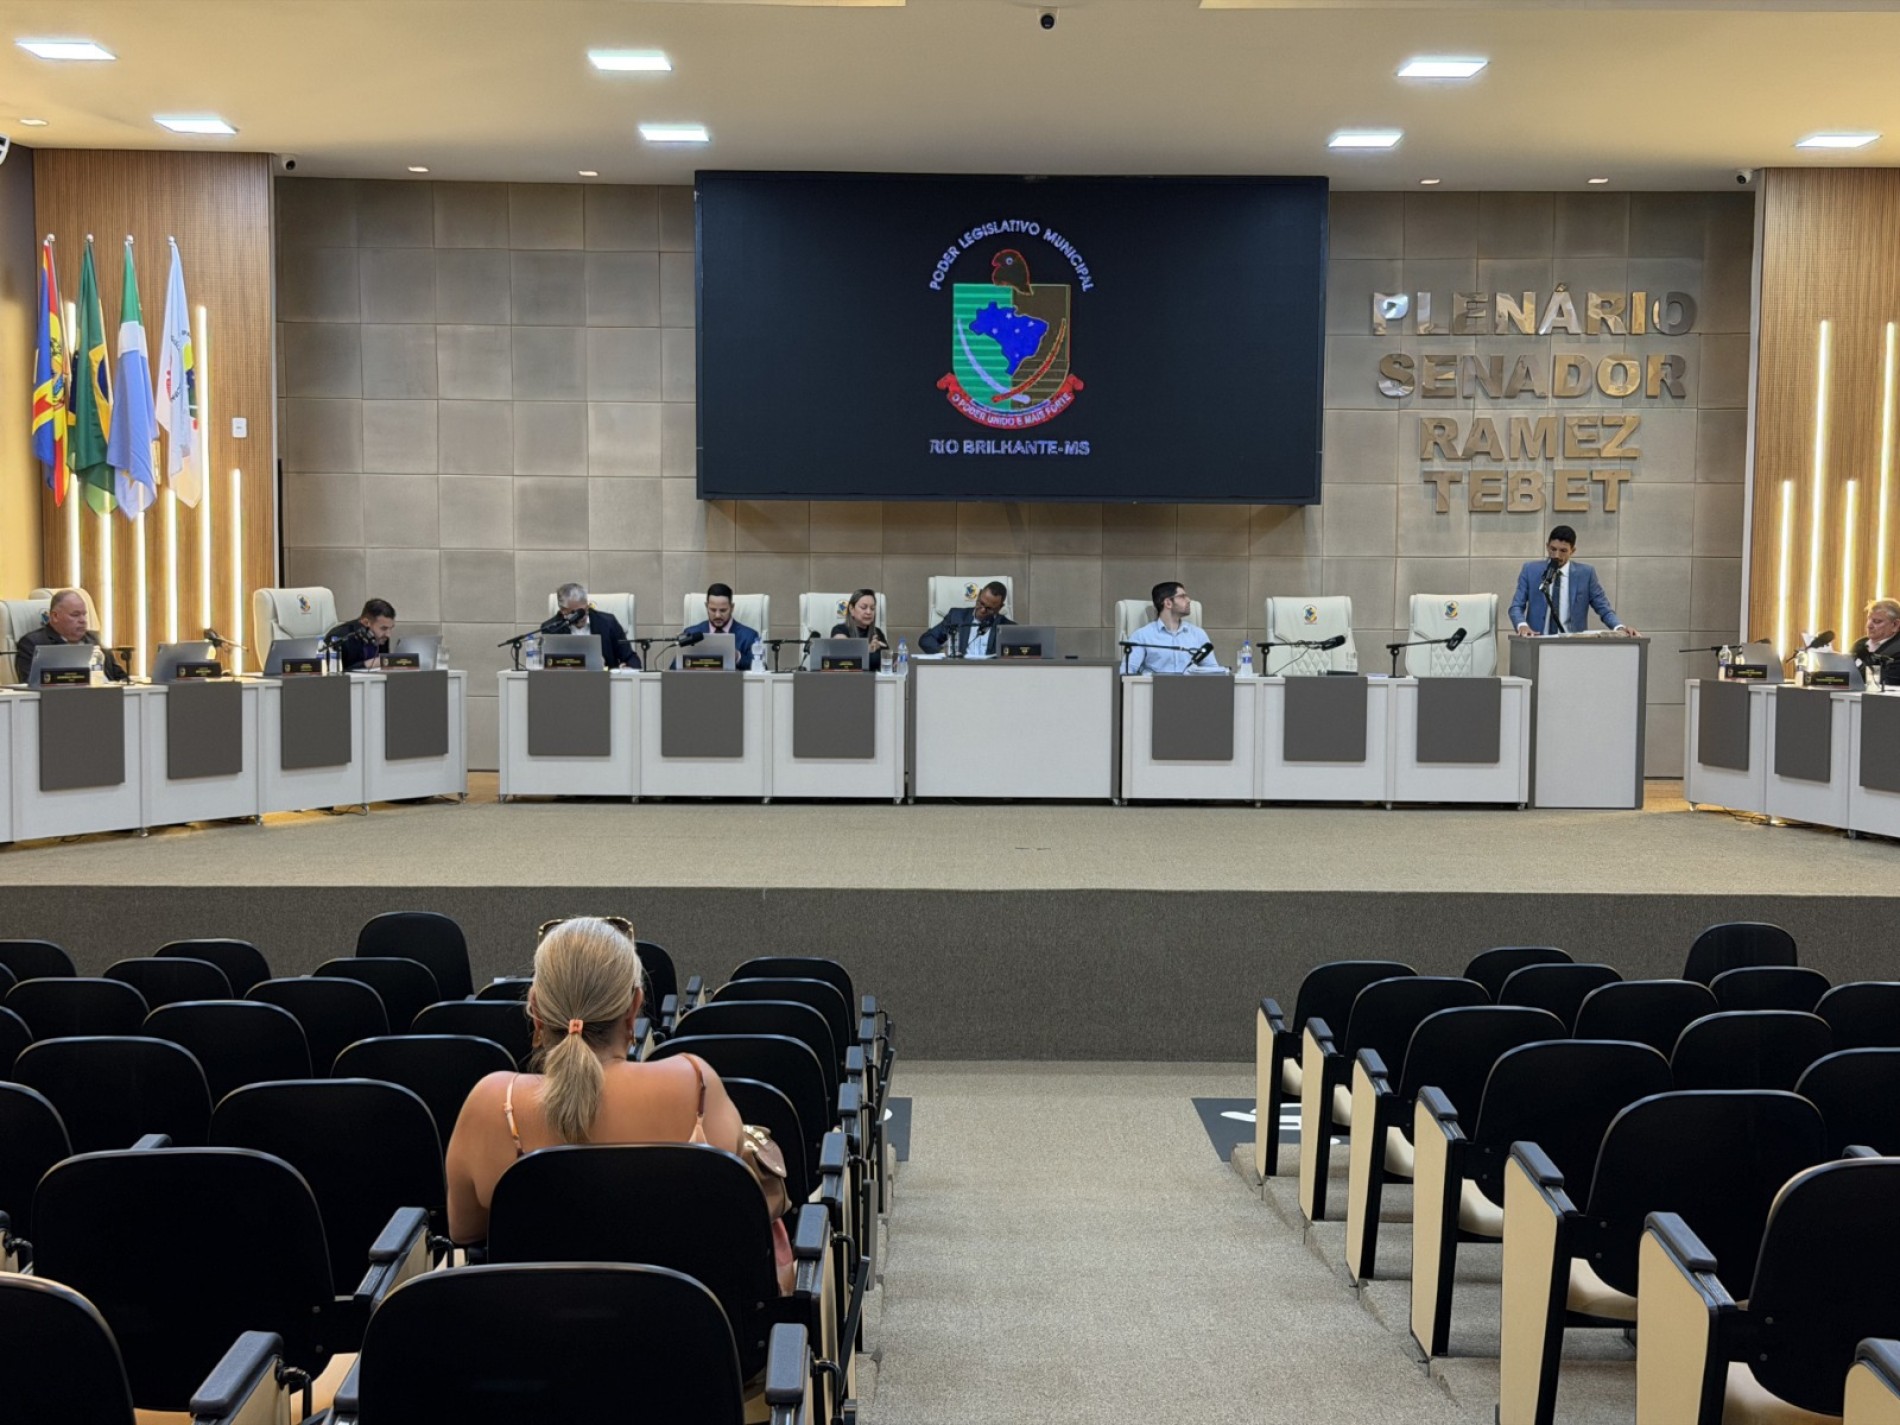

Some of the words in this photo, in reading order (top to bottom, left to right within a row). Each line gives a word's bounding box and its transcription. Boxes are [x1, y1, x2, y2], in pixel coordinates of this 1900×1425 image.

[929, 245, 961, 291] PODER
[957, 219, 1040, 250] LEGISLATIVO
[1042, 228, 1095, 293] MUNICIPAL
[1373, 282, 1698, 336] PLENÁRIO
[1378, 352, 1687, 399] SENADOR
[958, 400, 985, 420] PODER
[1024, 411, 1046, 425] MAIS
[1044, 392, 1072, 415] FORTE
[929, 439, 960, 454] RIO
[962, 439, 1091, 456] BRILHANTE-MS
[1420, 415, 1641, 461] RAMEZ
[1423, 469, 1632, 513] TEBET
